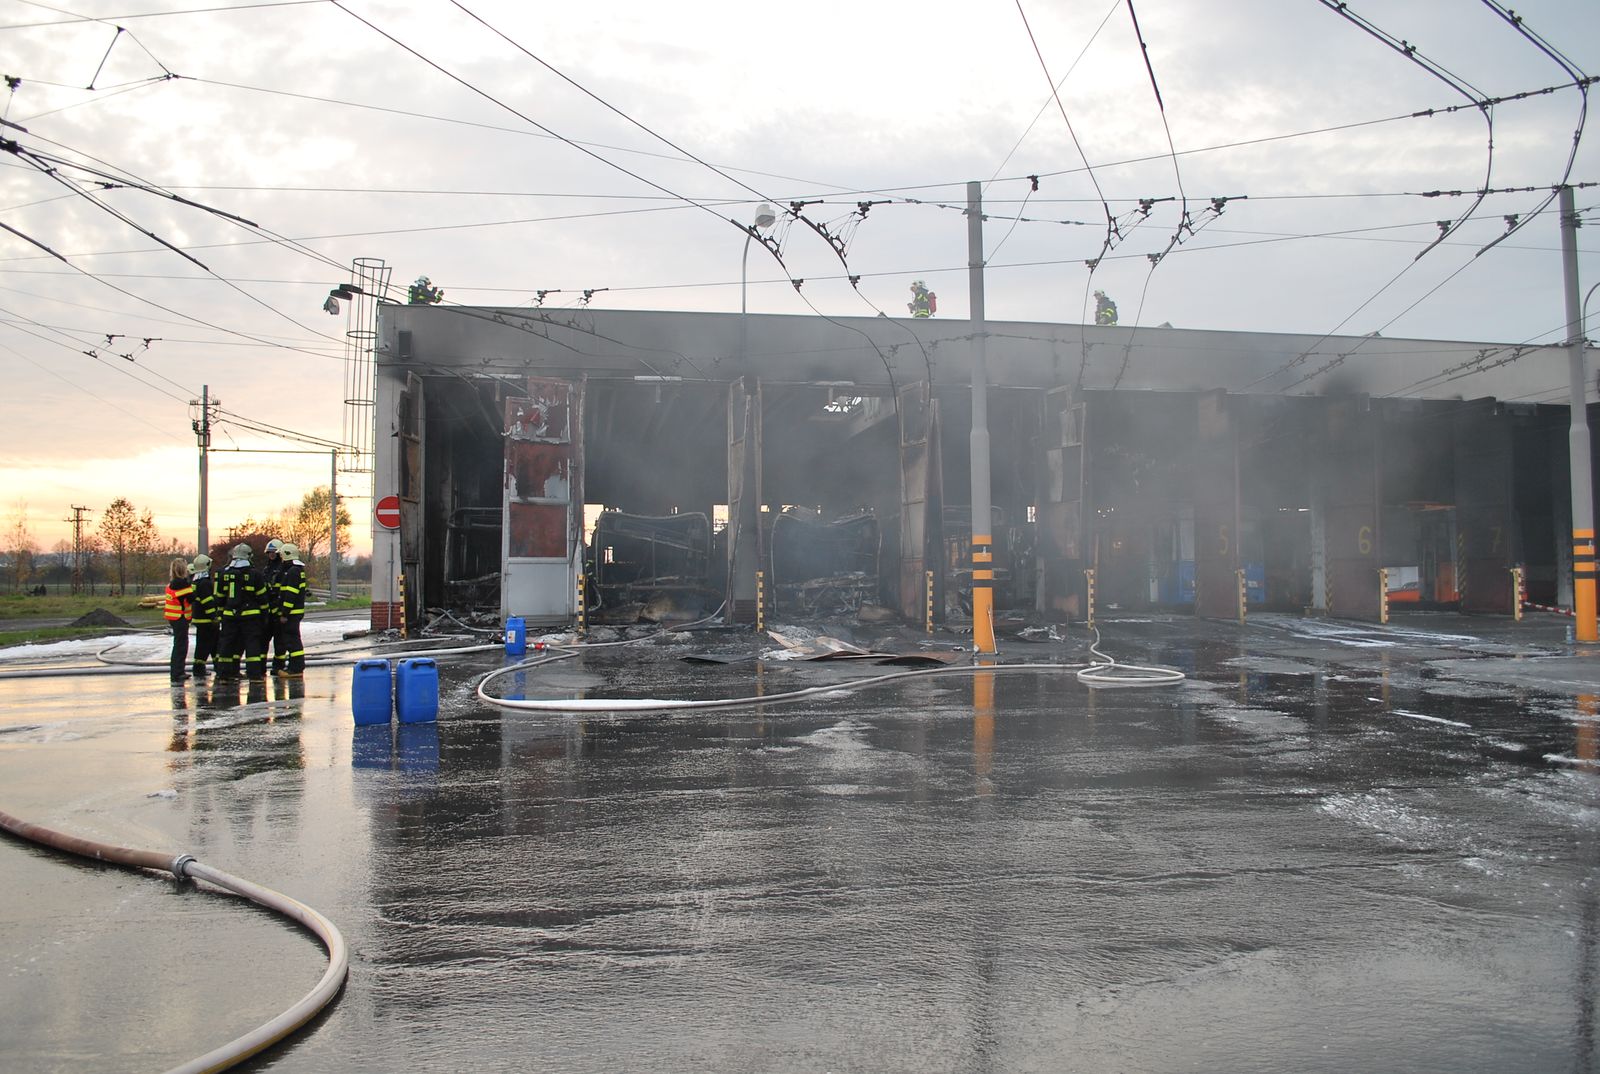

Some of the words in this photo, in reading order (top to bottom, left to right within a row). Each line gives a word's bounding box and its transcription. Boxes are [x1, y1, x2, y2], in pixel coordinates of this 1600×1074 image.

[1219, 525, 1228, 555] 5
[1359, 526, 1371, 554] 6
[1490, 527, 1501, 553] 7
